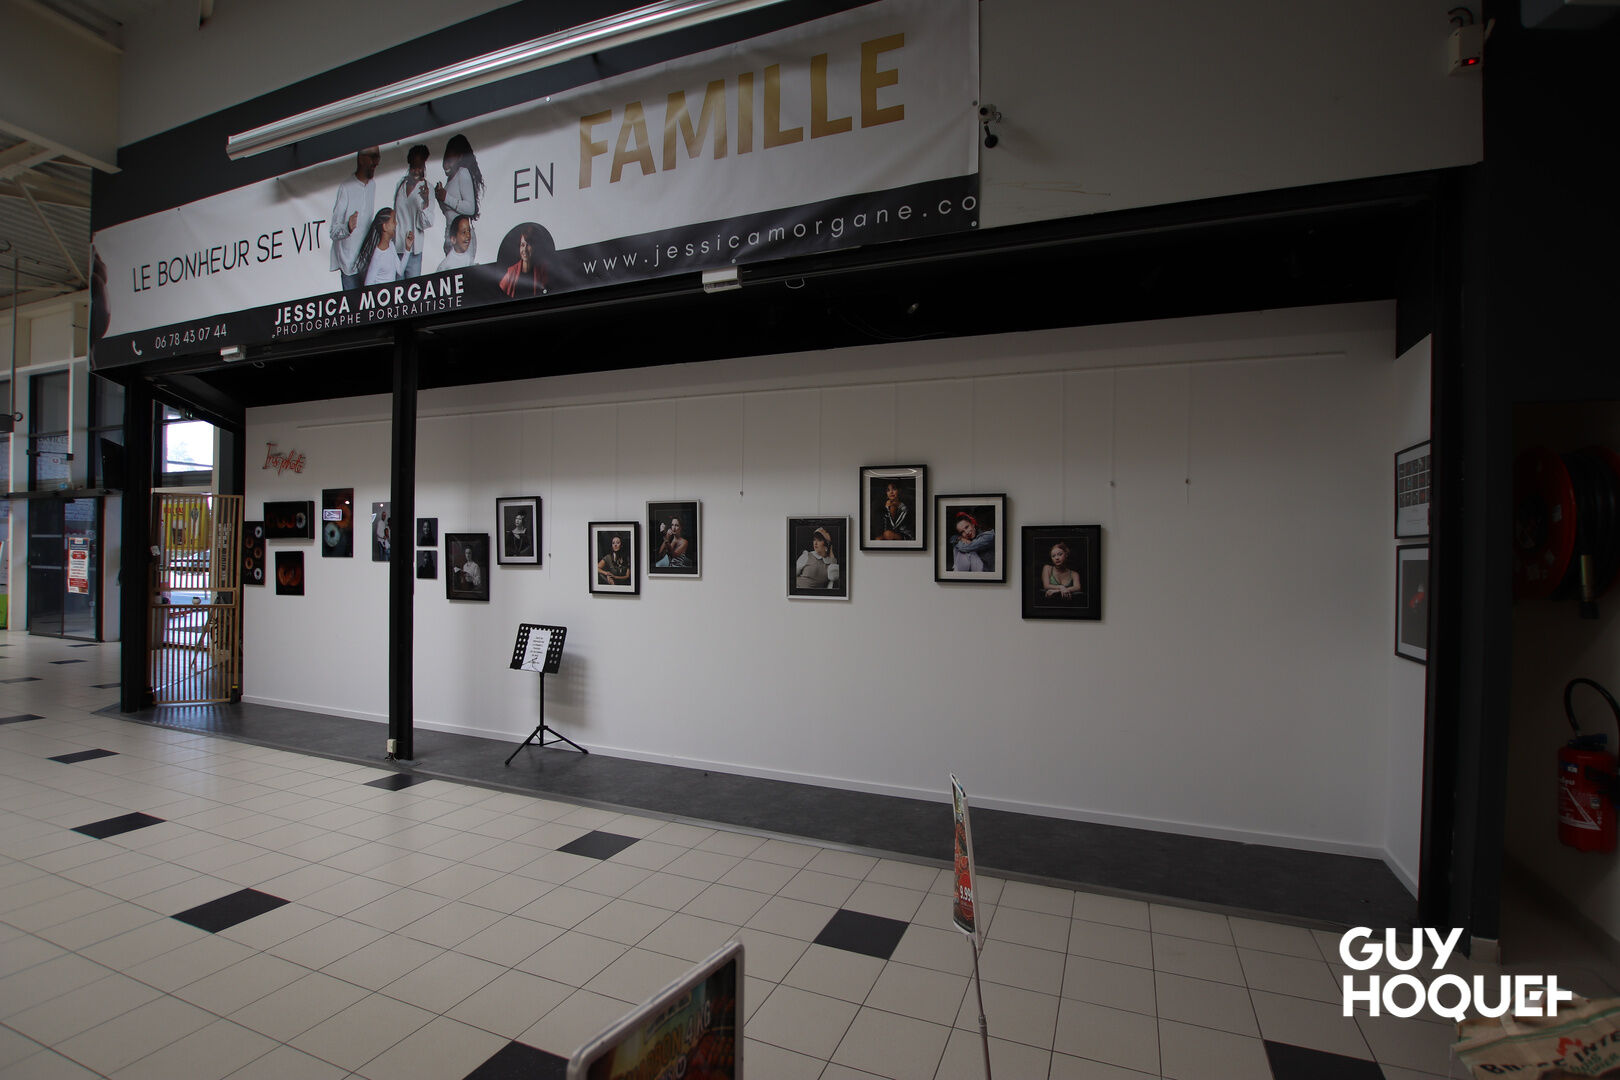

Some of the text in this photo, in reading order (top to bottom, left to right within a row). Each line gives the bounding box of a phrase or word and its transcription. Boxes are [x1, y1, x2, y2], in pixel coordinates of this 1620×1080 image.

[577, 32, 905, 190] FAMILLE
[513, 162, 555, 204] EN
[133, 219, 326, 293] LE BONHEUR SE VIT
[582, 194, 977, 275] www.jessicamorgane.co
[275, 274, 465, 326] JESSICA MORGANE
[276, 295, 462, 337] PHOTOGRAPHE PORTRAITISTE
[155, 323, 227, 349] 06 78 43 07 44
